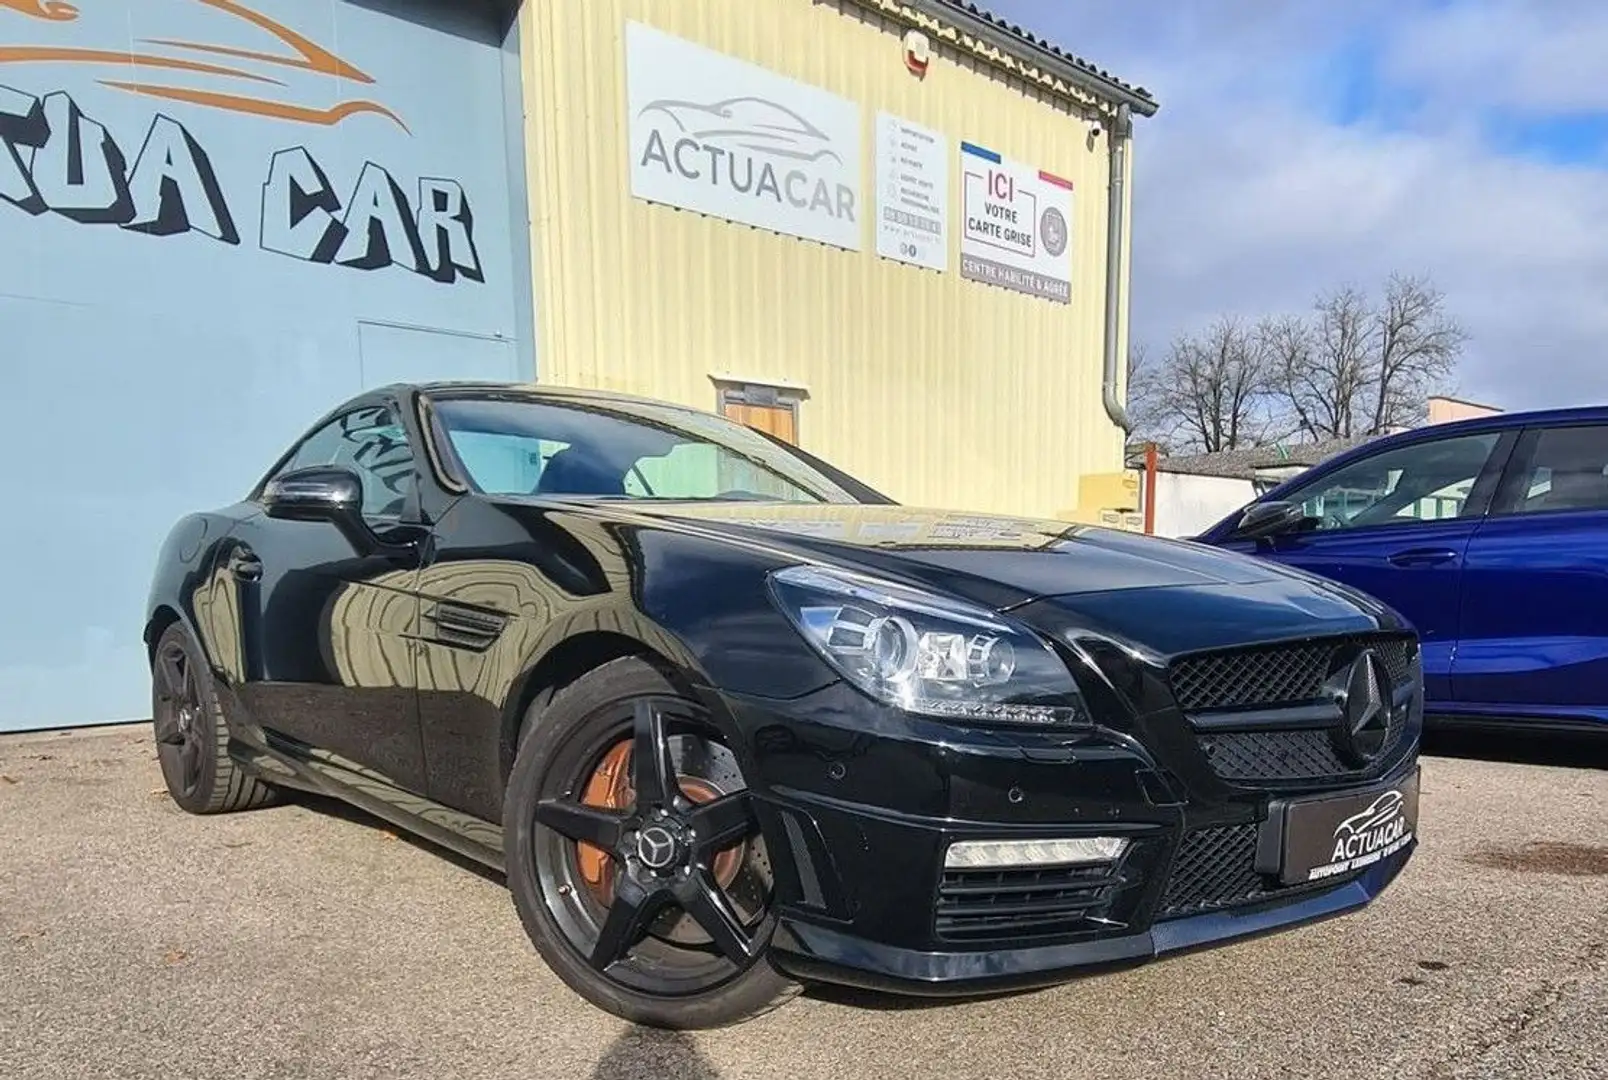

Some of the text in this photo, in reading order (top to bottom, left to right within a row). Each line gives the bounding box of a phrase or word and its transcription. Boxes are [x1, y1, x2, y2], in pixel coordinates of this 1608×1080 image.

[640, 129, 856, 222] ACTUACAR
[988, 170, 1013, 202] ICI
[259, 146, 485, 284] CAR
[984, 201, 1018, 224] VOTRE
[968, 218, 1032, 248] CARTE GRISE
[963, 259, 996, 278] CENTRE
